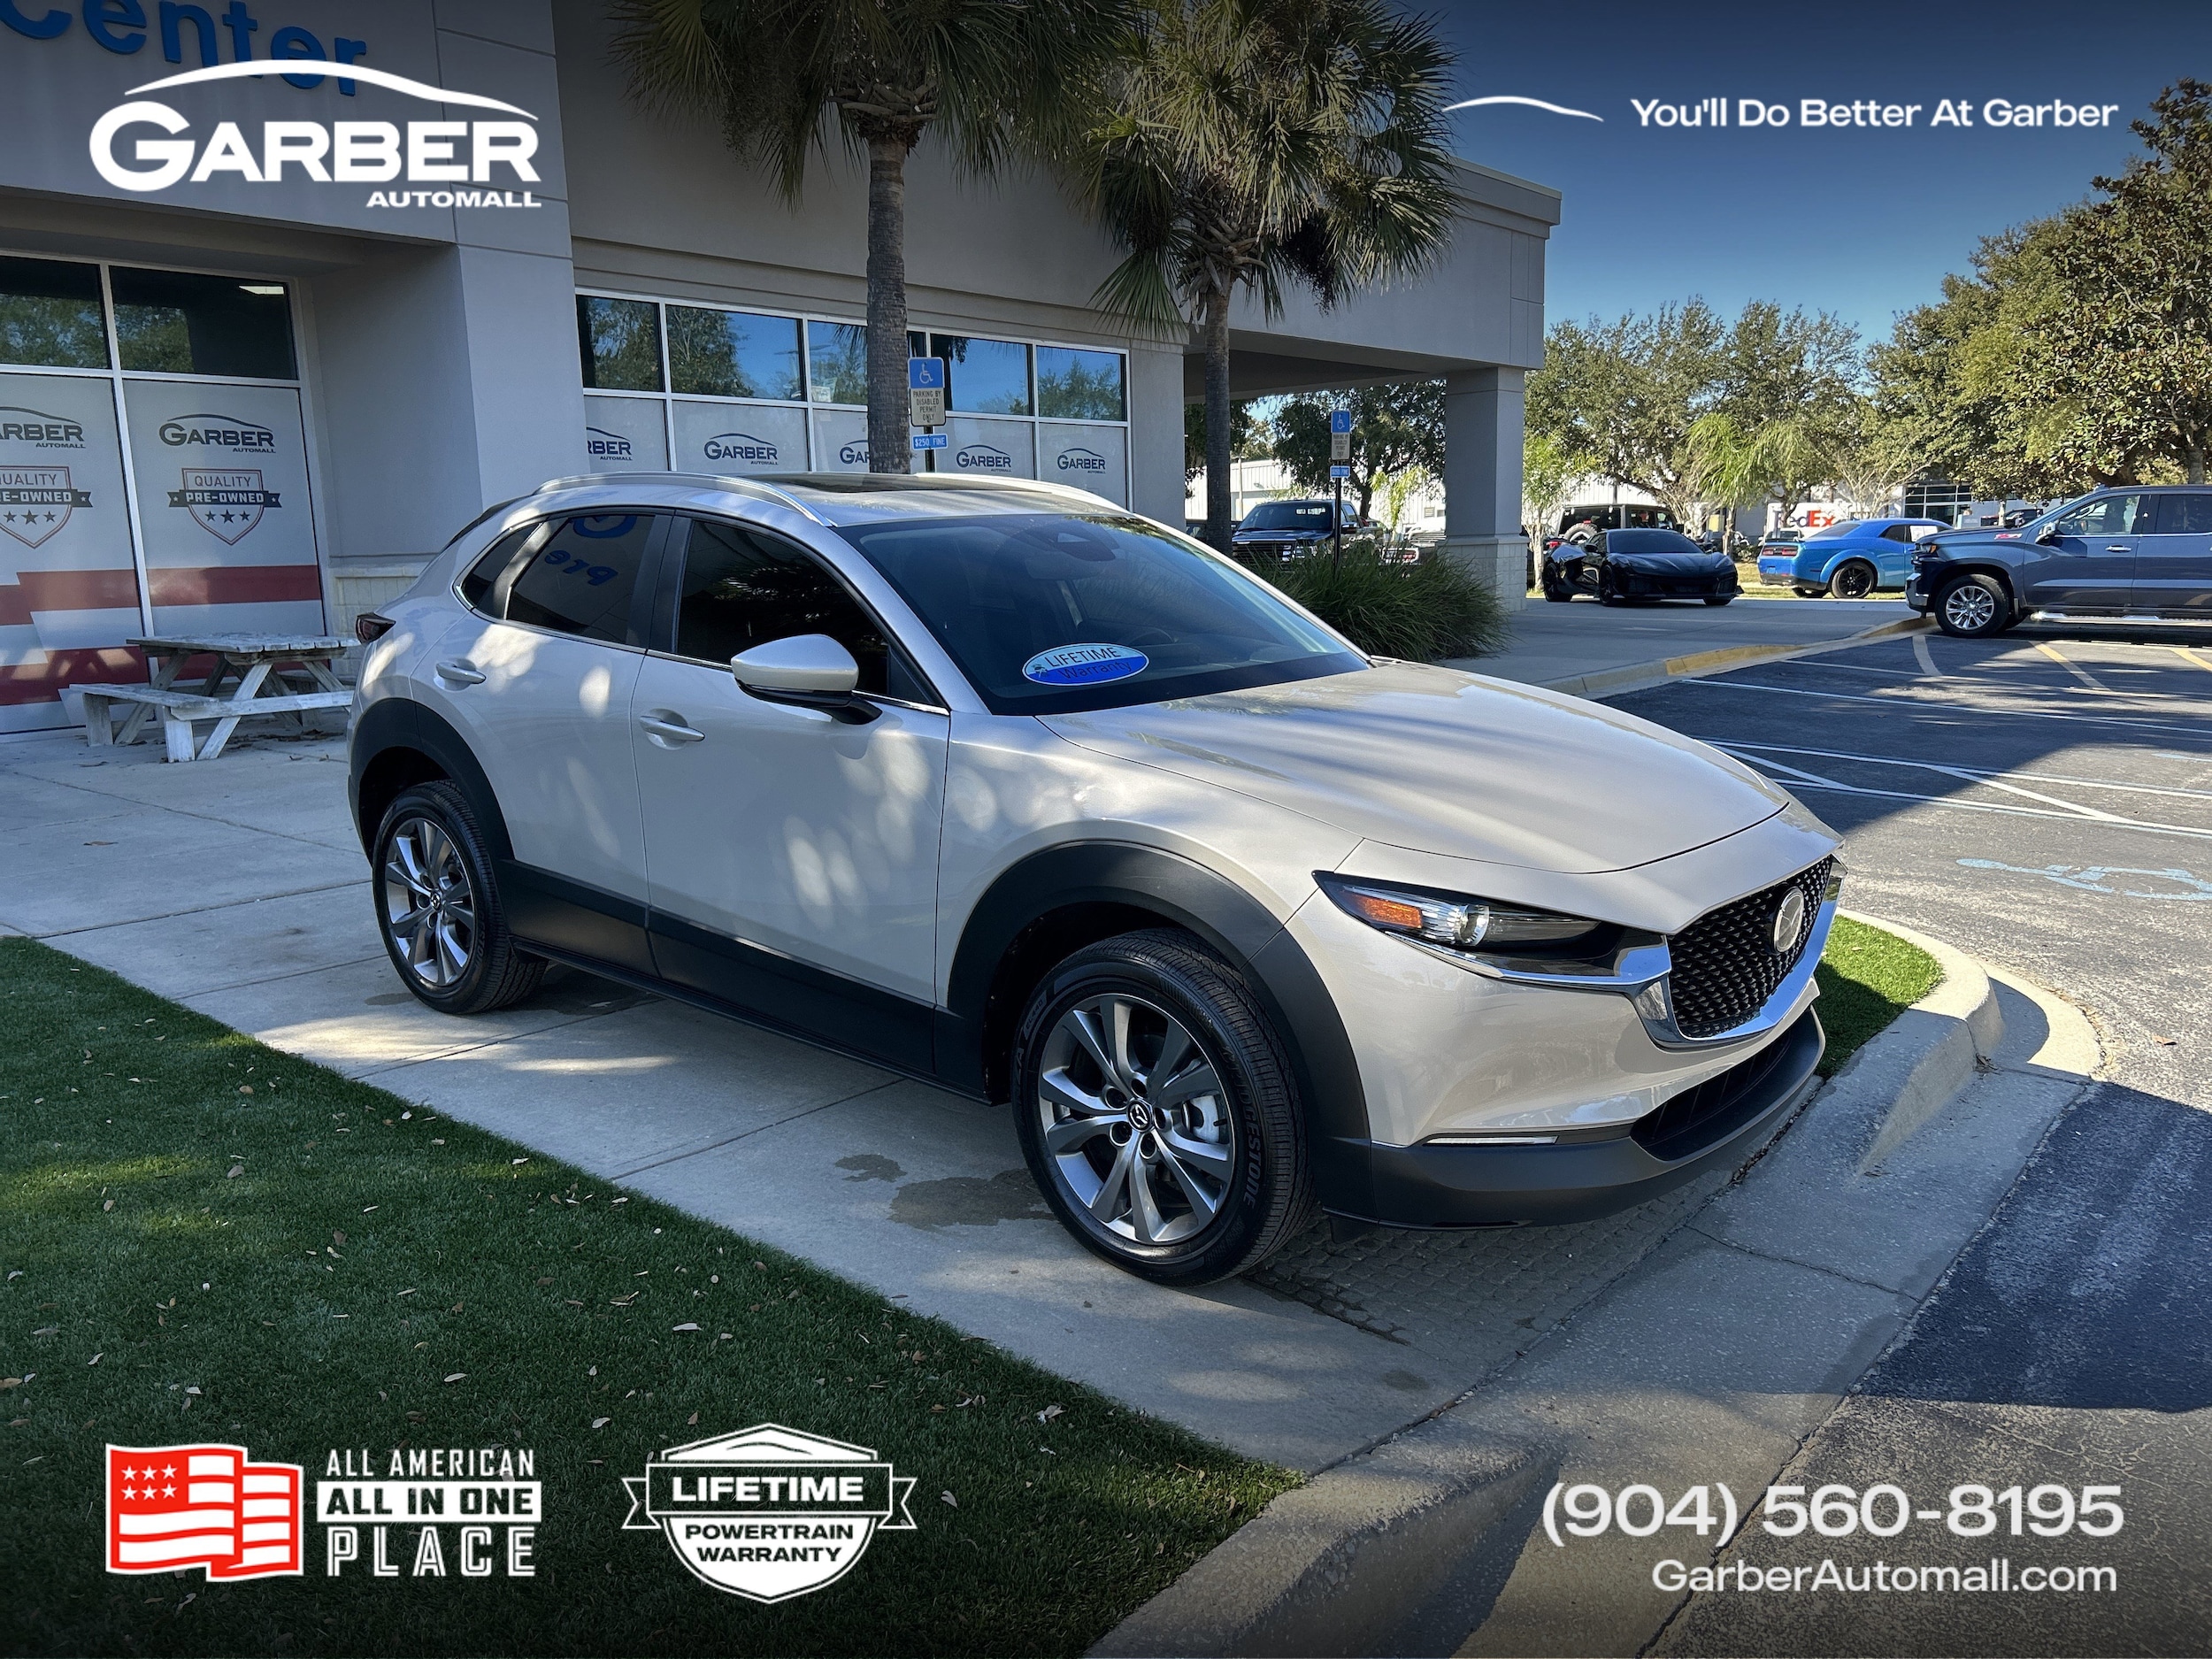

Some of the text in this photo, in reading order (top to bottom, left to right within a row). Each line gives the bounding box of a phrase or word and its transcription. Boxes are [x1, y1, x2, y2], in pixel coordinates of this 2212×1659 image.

[0, 423, 85, 442] RBER
[159, 423, 275, 447] GARBER
[703, 441, 779, 460] GARBER
[914, 436, 946, 448] $250 FINE
[956, 451, 1011, 468] GARBER
[1056, 454, 1106, 471] GARBER
[0, 473, 57, 486] UALITY
[194, 475, 251, 488] QUALITY
[0, 491, 72, 503] E-OWNED
[185, 492, 265, 503] PRE-OWNED
[1772, 509, 1835, 528] FedEx
[1044, 647, 1122, 667] LIFETIME
[1057, 659, 1133, 680] Warranty
